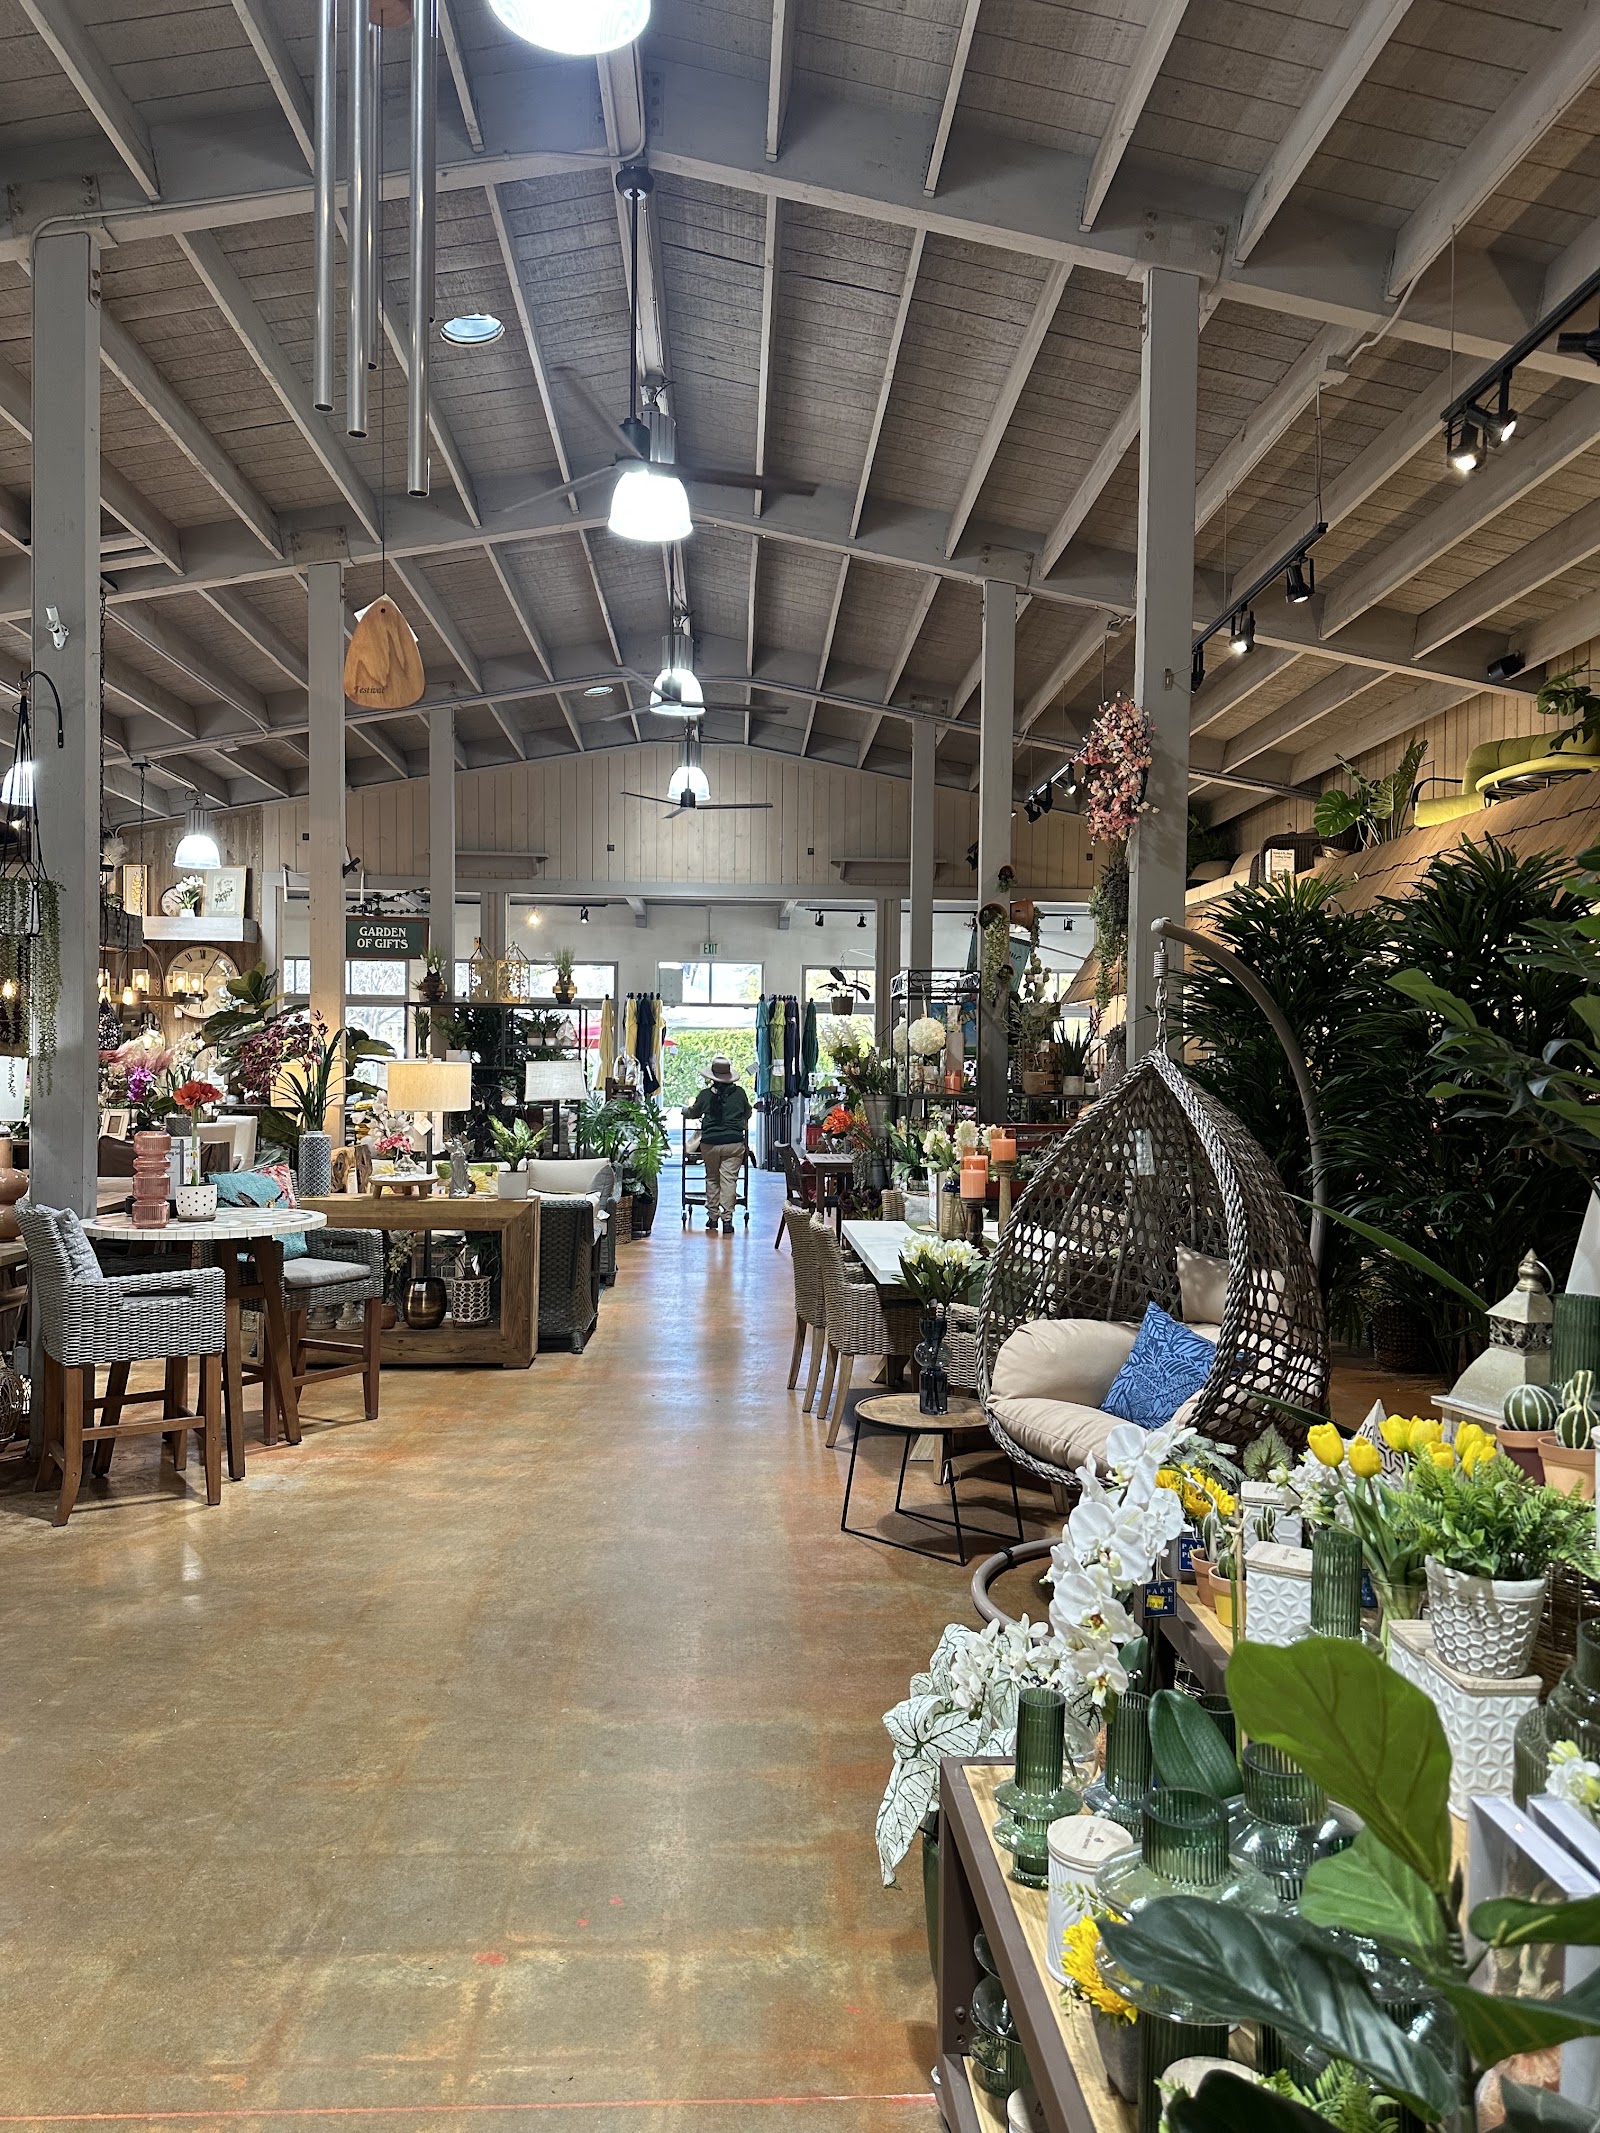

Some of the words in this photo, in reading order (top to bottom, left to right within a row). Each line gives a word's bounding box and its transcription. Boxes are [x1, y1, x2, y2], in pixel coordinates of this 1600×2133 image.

[359, 926, 406, 938] GARDEN
[357, 938, 372, 948] OF
[374, 939, 409, 949] GIFTS
[703, 943, 718, 954] EXIT
[1146, 1586, 1173, 1595] PARK
